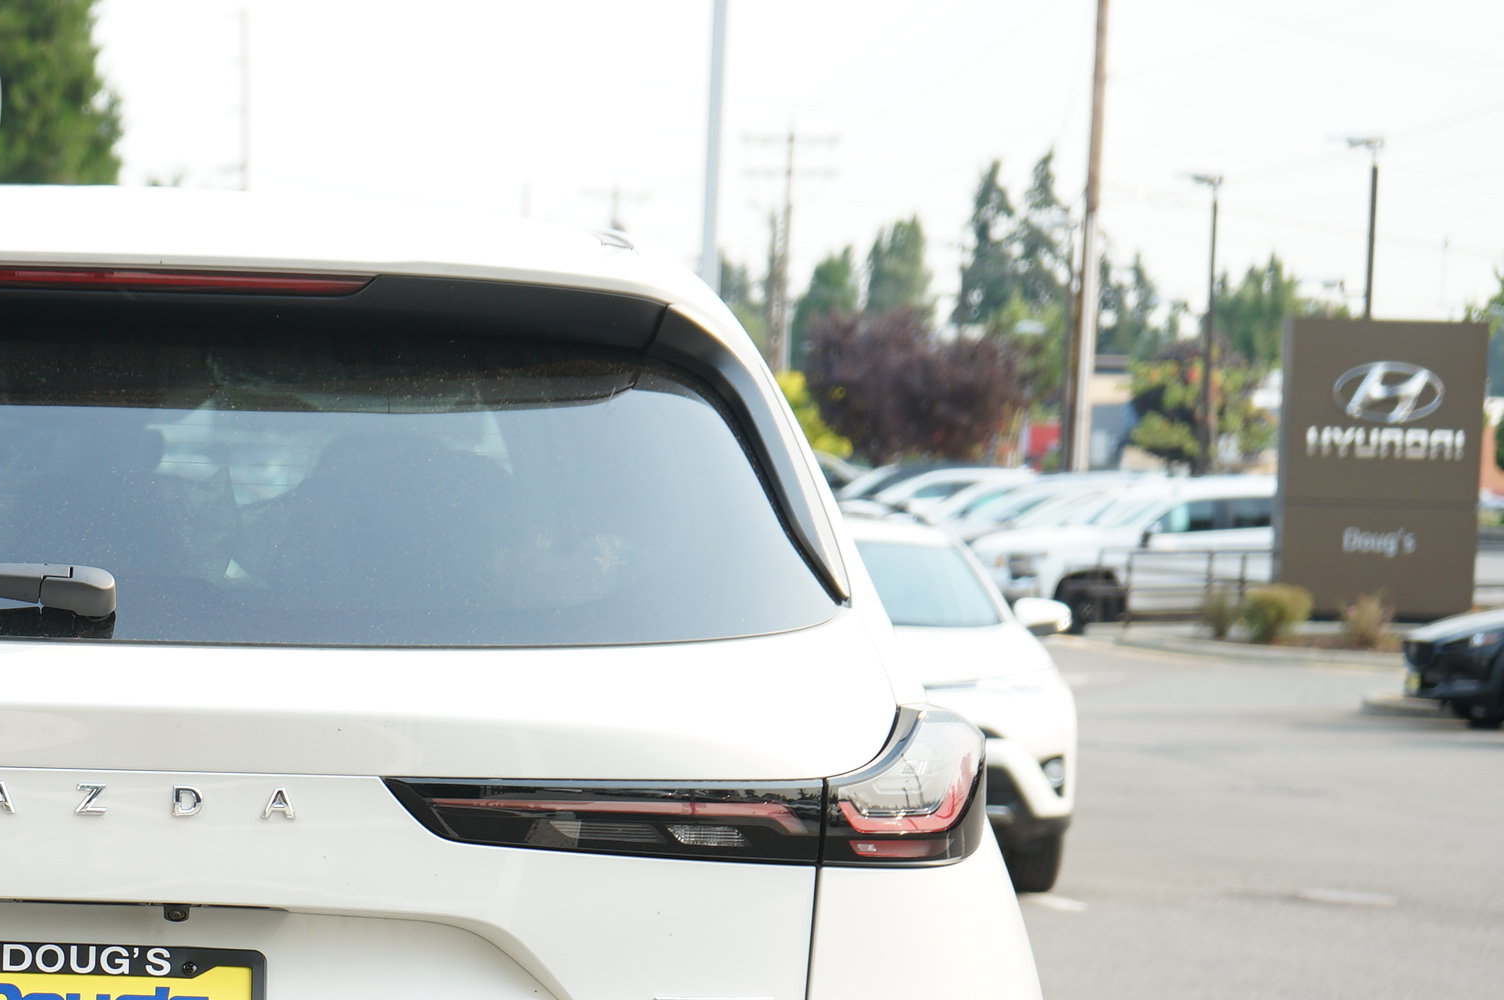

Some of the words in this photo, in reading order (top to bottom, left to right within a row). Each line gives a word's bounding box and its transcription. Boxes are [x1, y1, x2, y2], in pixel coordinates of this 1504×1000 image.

[1306, 425, 1466, 461] HYUNDAI
[1343, 526, 1417, 558] Doug's
[1, 943, 172, 976] DOUG'S
